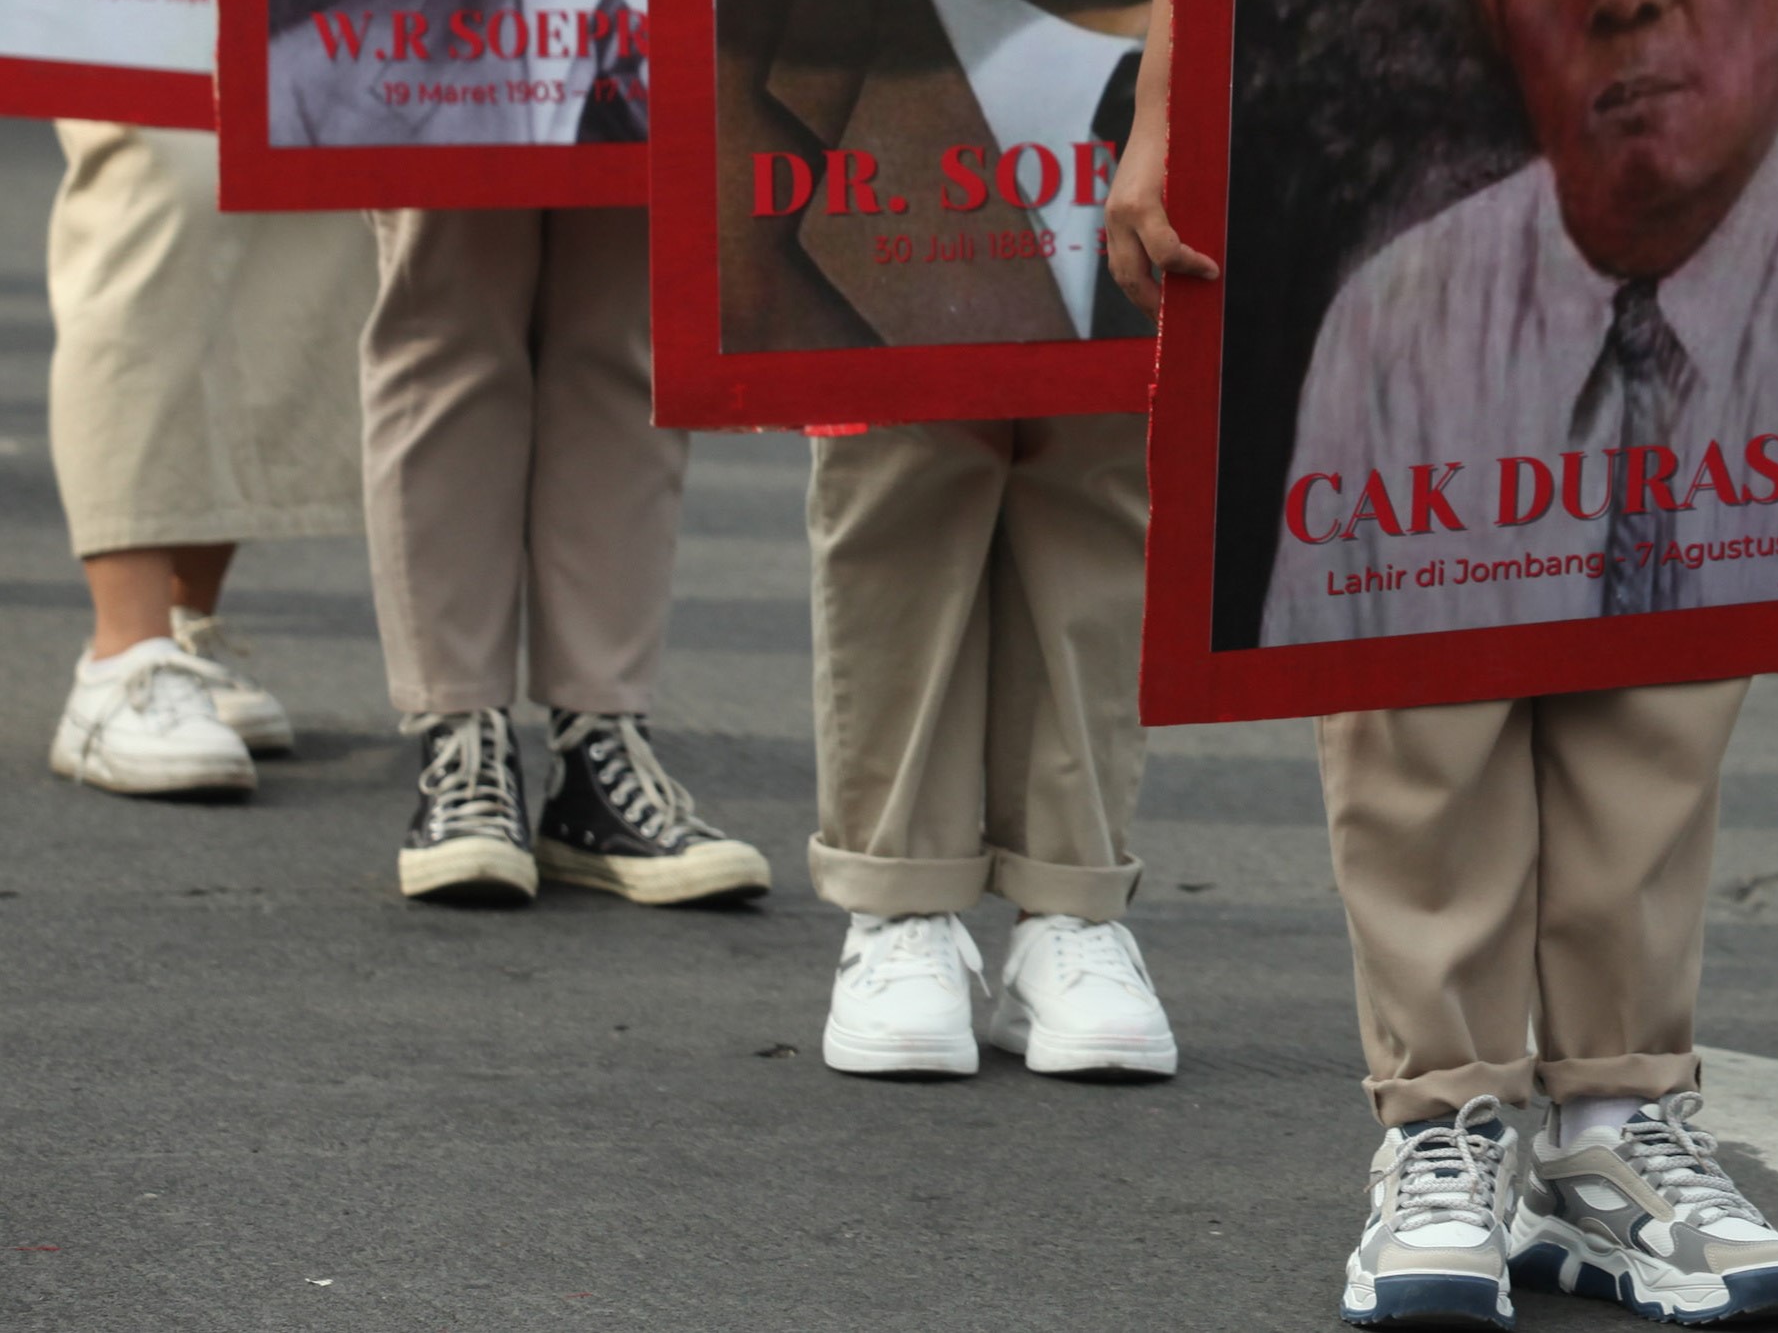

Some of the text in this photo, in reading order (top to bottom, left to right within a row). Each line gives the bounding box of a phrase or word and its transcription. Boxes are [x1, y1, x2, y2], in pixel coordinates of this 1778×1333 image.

[311, 9, 648, 61] W.R SOEPR
[385, 83, 410, 106] 19
[419, 81, 496, 104] Maret
[507, 82, 565, 104] 1903
[750, 140, 1117, 217] DR. SOE
[873, 235, 912, 264] 30
[923, 233, 975, 262] Juli
[987, 229, 1057, 260] 1888
[1285, 462, 1466, 545] CAK
[1326, 563, 1404, 596] Lahir
[1414, 560, 1444, 588] di
[1455, 547, 1606, 586] Jombang
[1634, 544, 1654, 568] 7
